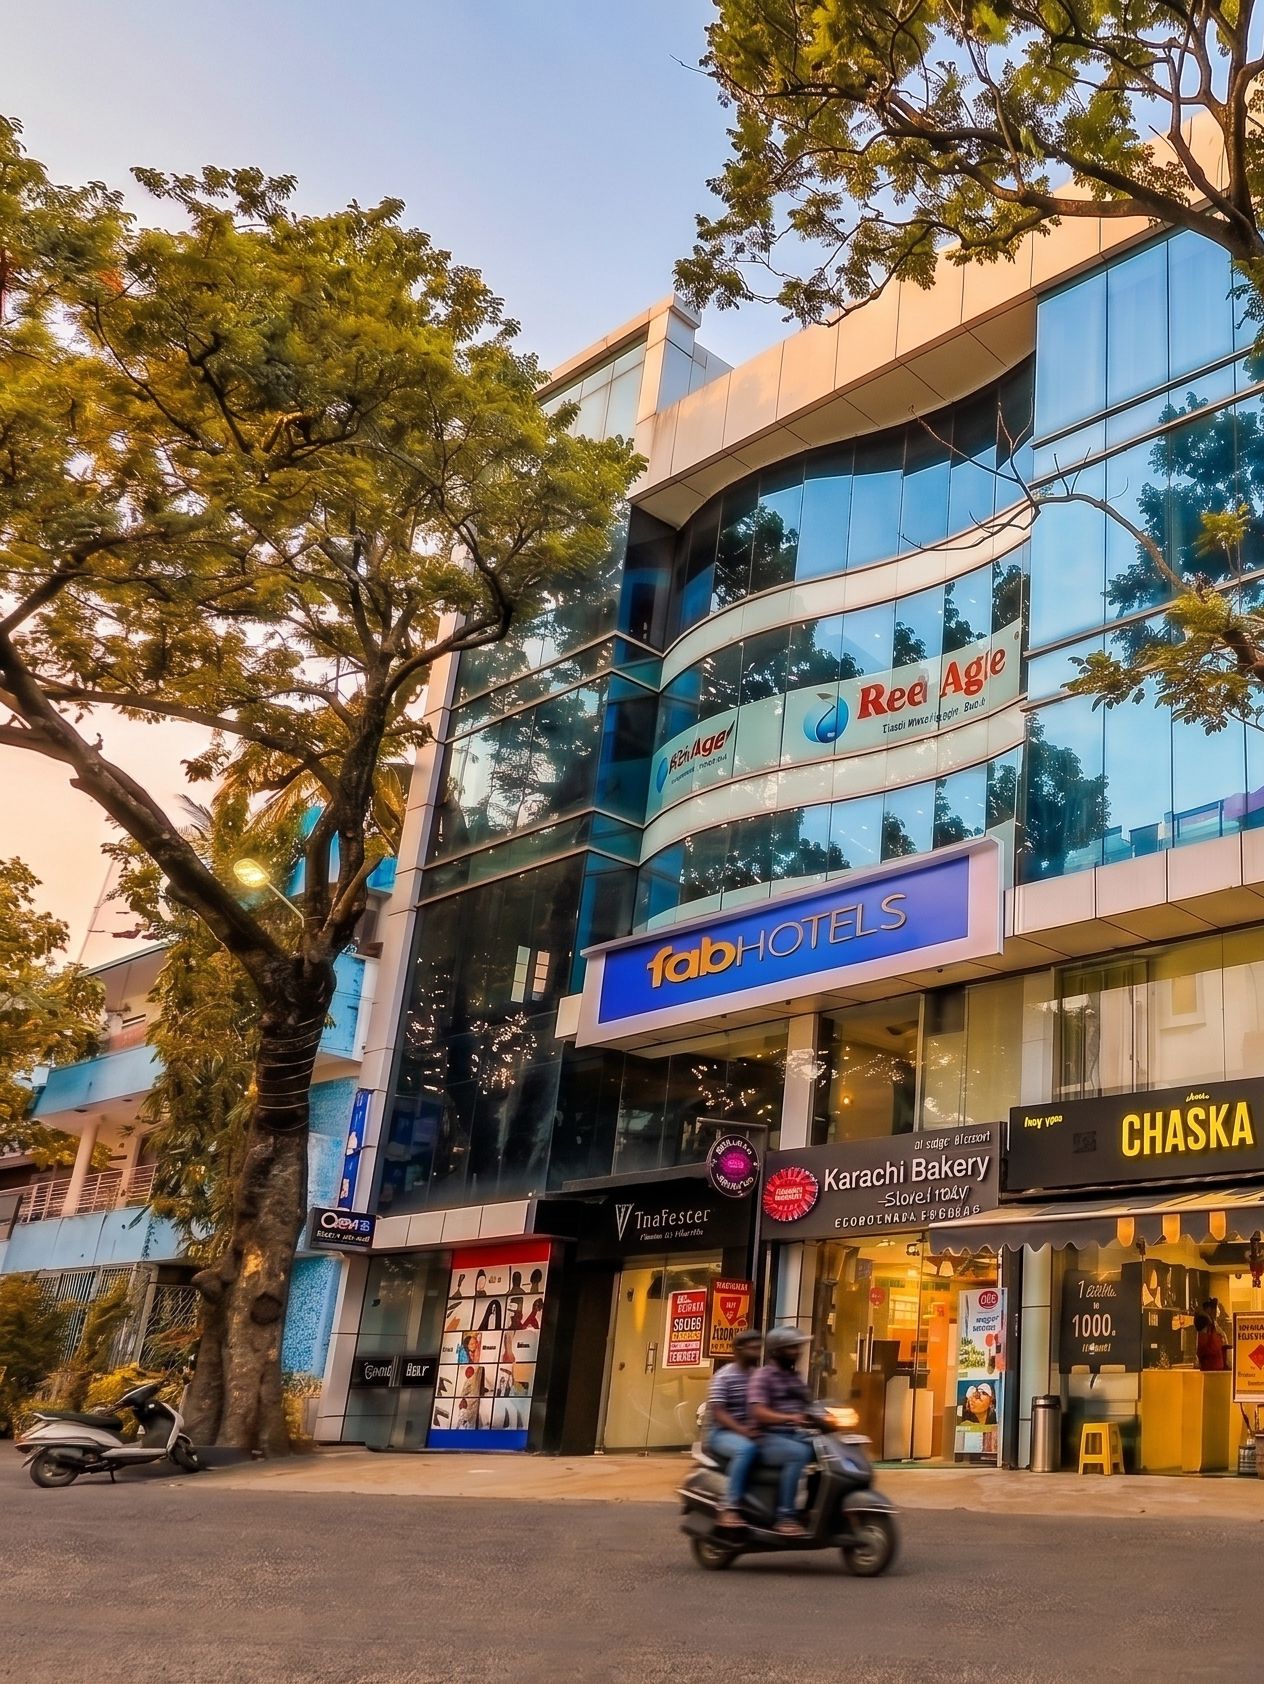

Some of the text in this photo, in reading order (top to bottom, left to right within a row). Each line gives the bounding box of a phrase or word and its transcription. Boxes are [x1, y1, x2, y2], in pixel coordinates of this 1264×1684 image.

[646, 893, 908, 989] fabHOTELS
[1121, 1101, 1254, 1158] CHASKA
[824, 1154, 990, 1192] Karachi Bakery
